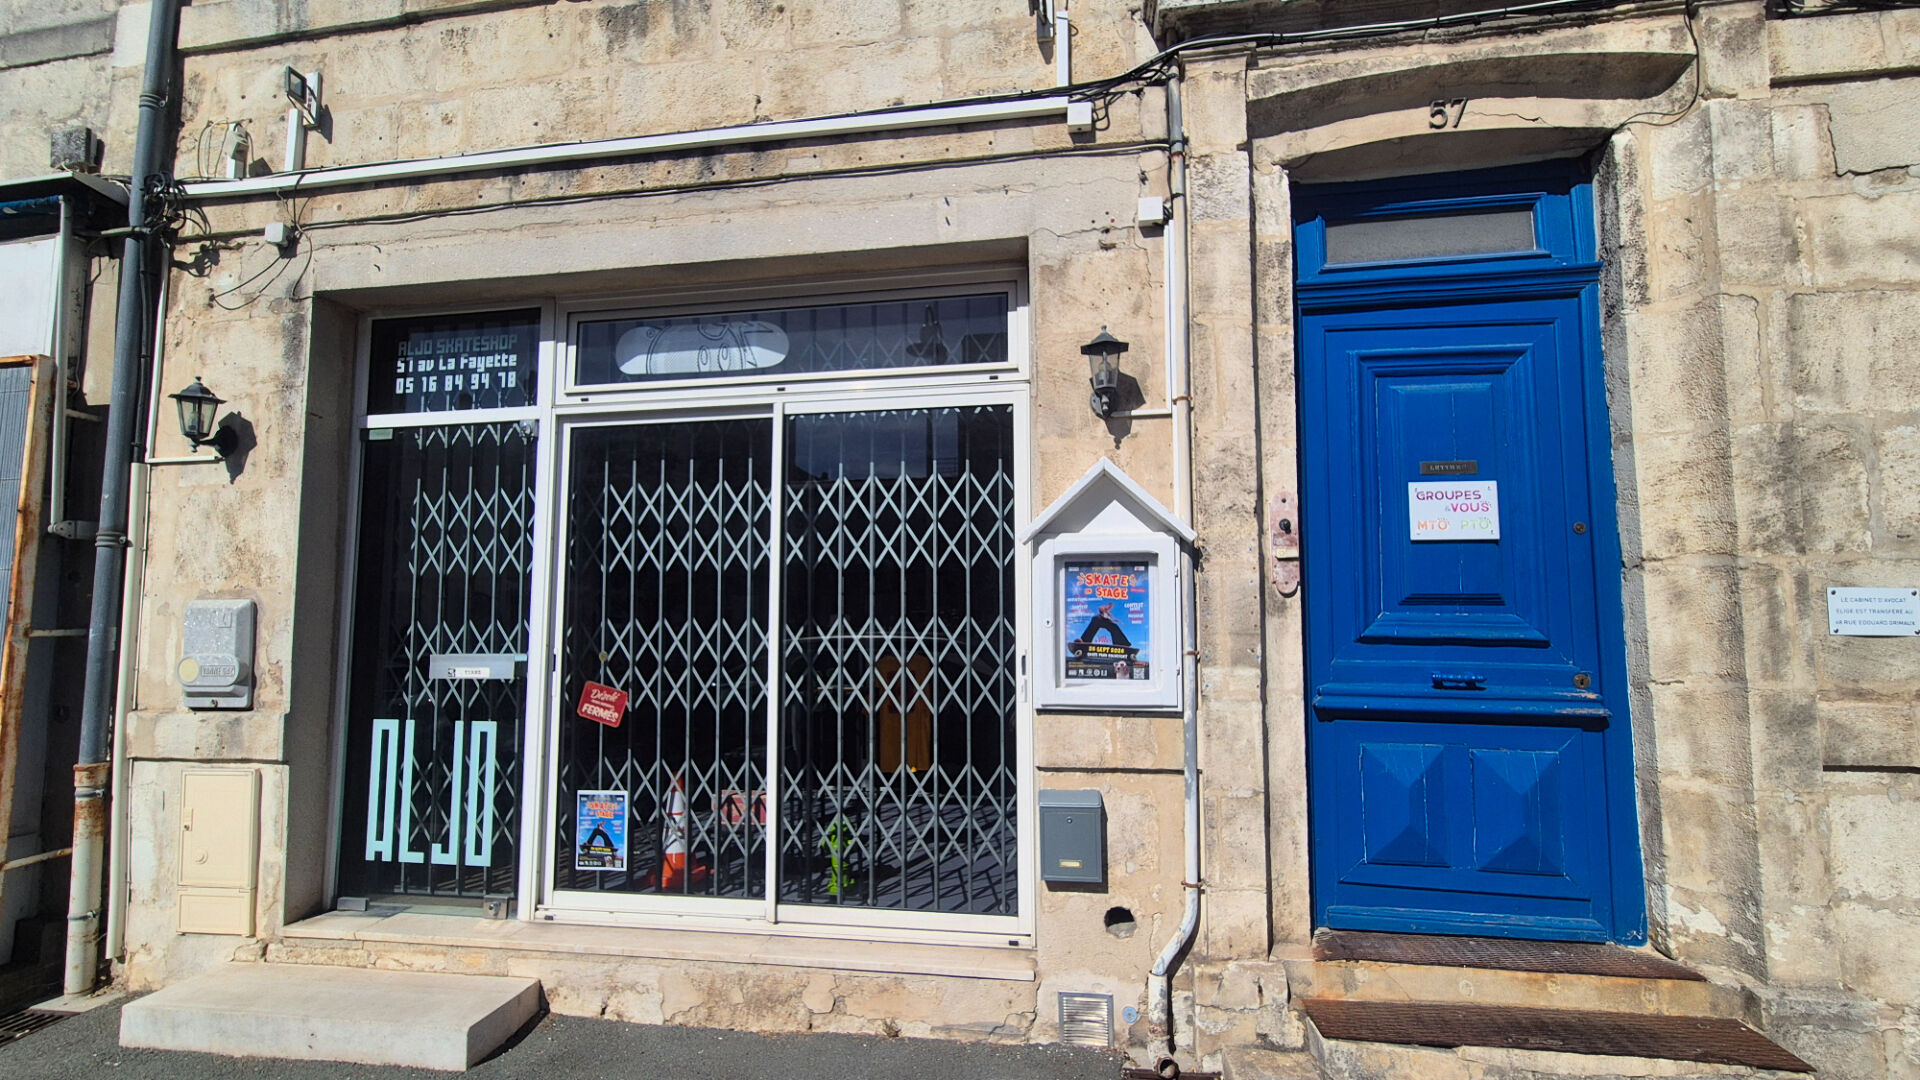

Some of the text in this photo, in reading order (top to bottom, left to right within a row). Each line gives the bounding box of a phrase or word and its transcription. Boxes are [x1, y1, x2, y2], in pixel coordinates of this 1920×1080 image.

[1428, 97, 1468, 129] 57
[398, 335, 517, 356] ALJO SKATESHOP
[418, 360, 434, 372] av
[439, 356, 455, 370] La
[460, 353, 517, 372] Fayette
[395, 371, 517, 394] 05 16 84 94 78
[1416, 490, 1482, 501] GROUPES
[1450, 502, 1490, 513] VOUS
[1085, 573, 1129, 587] SKATE
[1096, 587, 1129, 599] STAGE
[365, 719, 497, 867] ALJO
